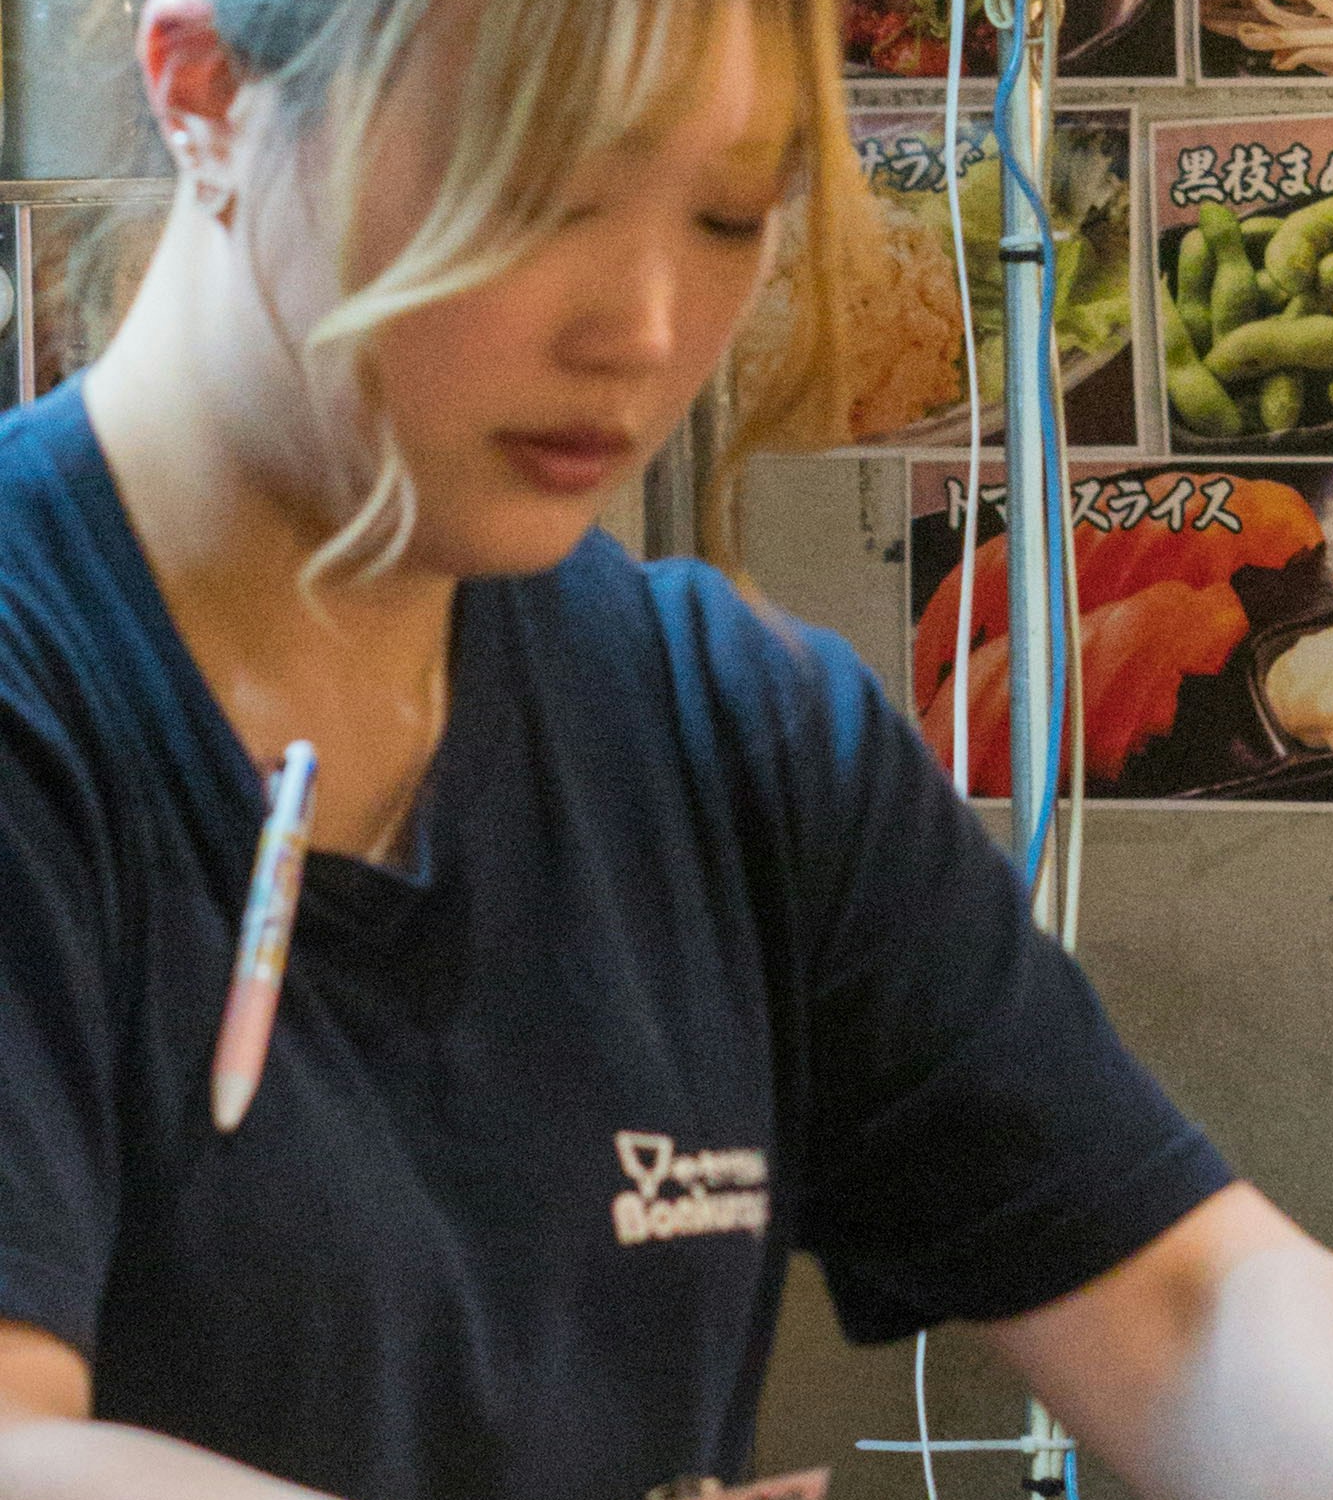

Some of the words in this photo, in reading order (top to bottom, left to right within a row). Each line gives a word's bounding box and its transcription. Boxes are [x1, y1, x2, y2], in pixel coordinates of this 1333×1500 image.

[944, 476, 1242, 535] トスライス
